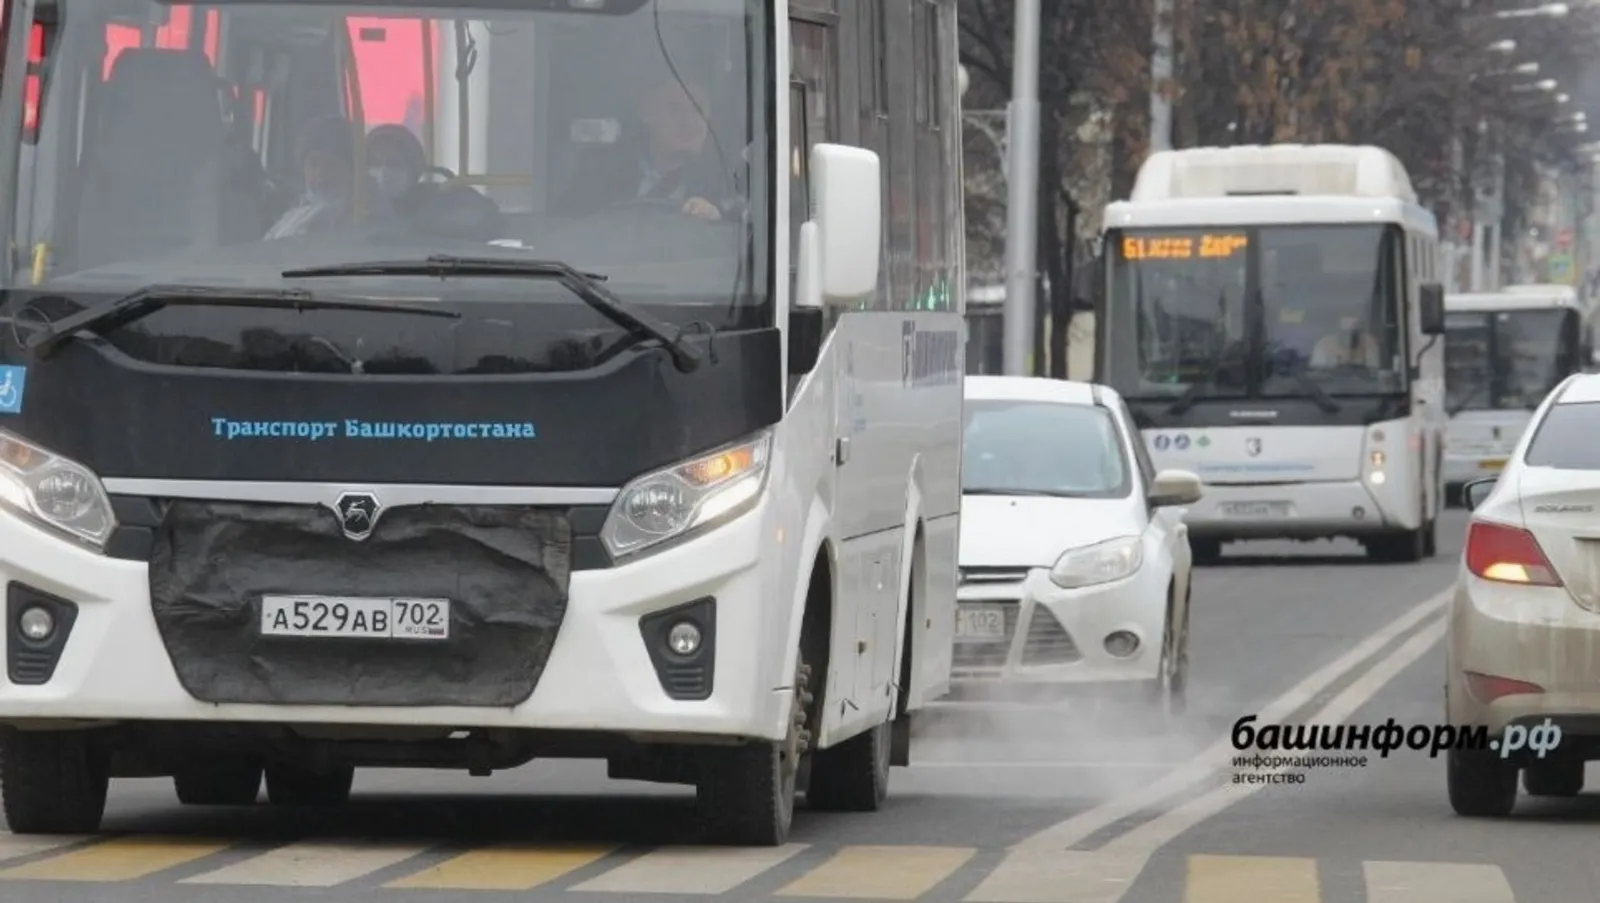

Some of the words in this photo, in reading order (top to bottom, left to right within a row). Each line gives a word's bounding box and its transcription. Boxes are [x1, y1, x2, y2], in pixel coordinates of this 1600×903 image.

[211, 418, 337, 440] Транспорт
[345, 419, 536, 441] Башкортостана
[272, 601, 388, 632] А529АВ
[395, 602, 440, 625] 702
